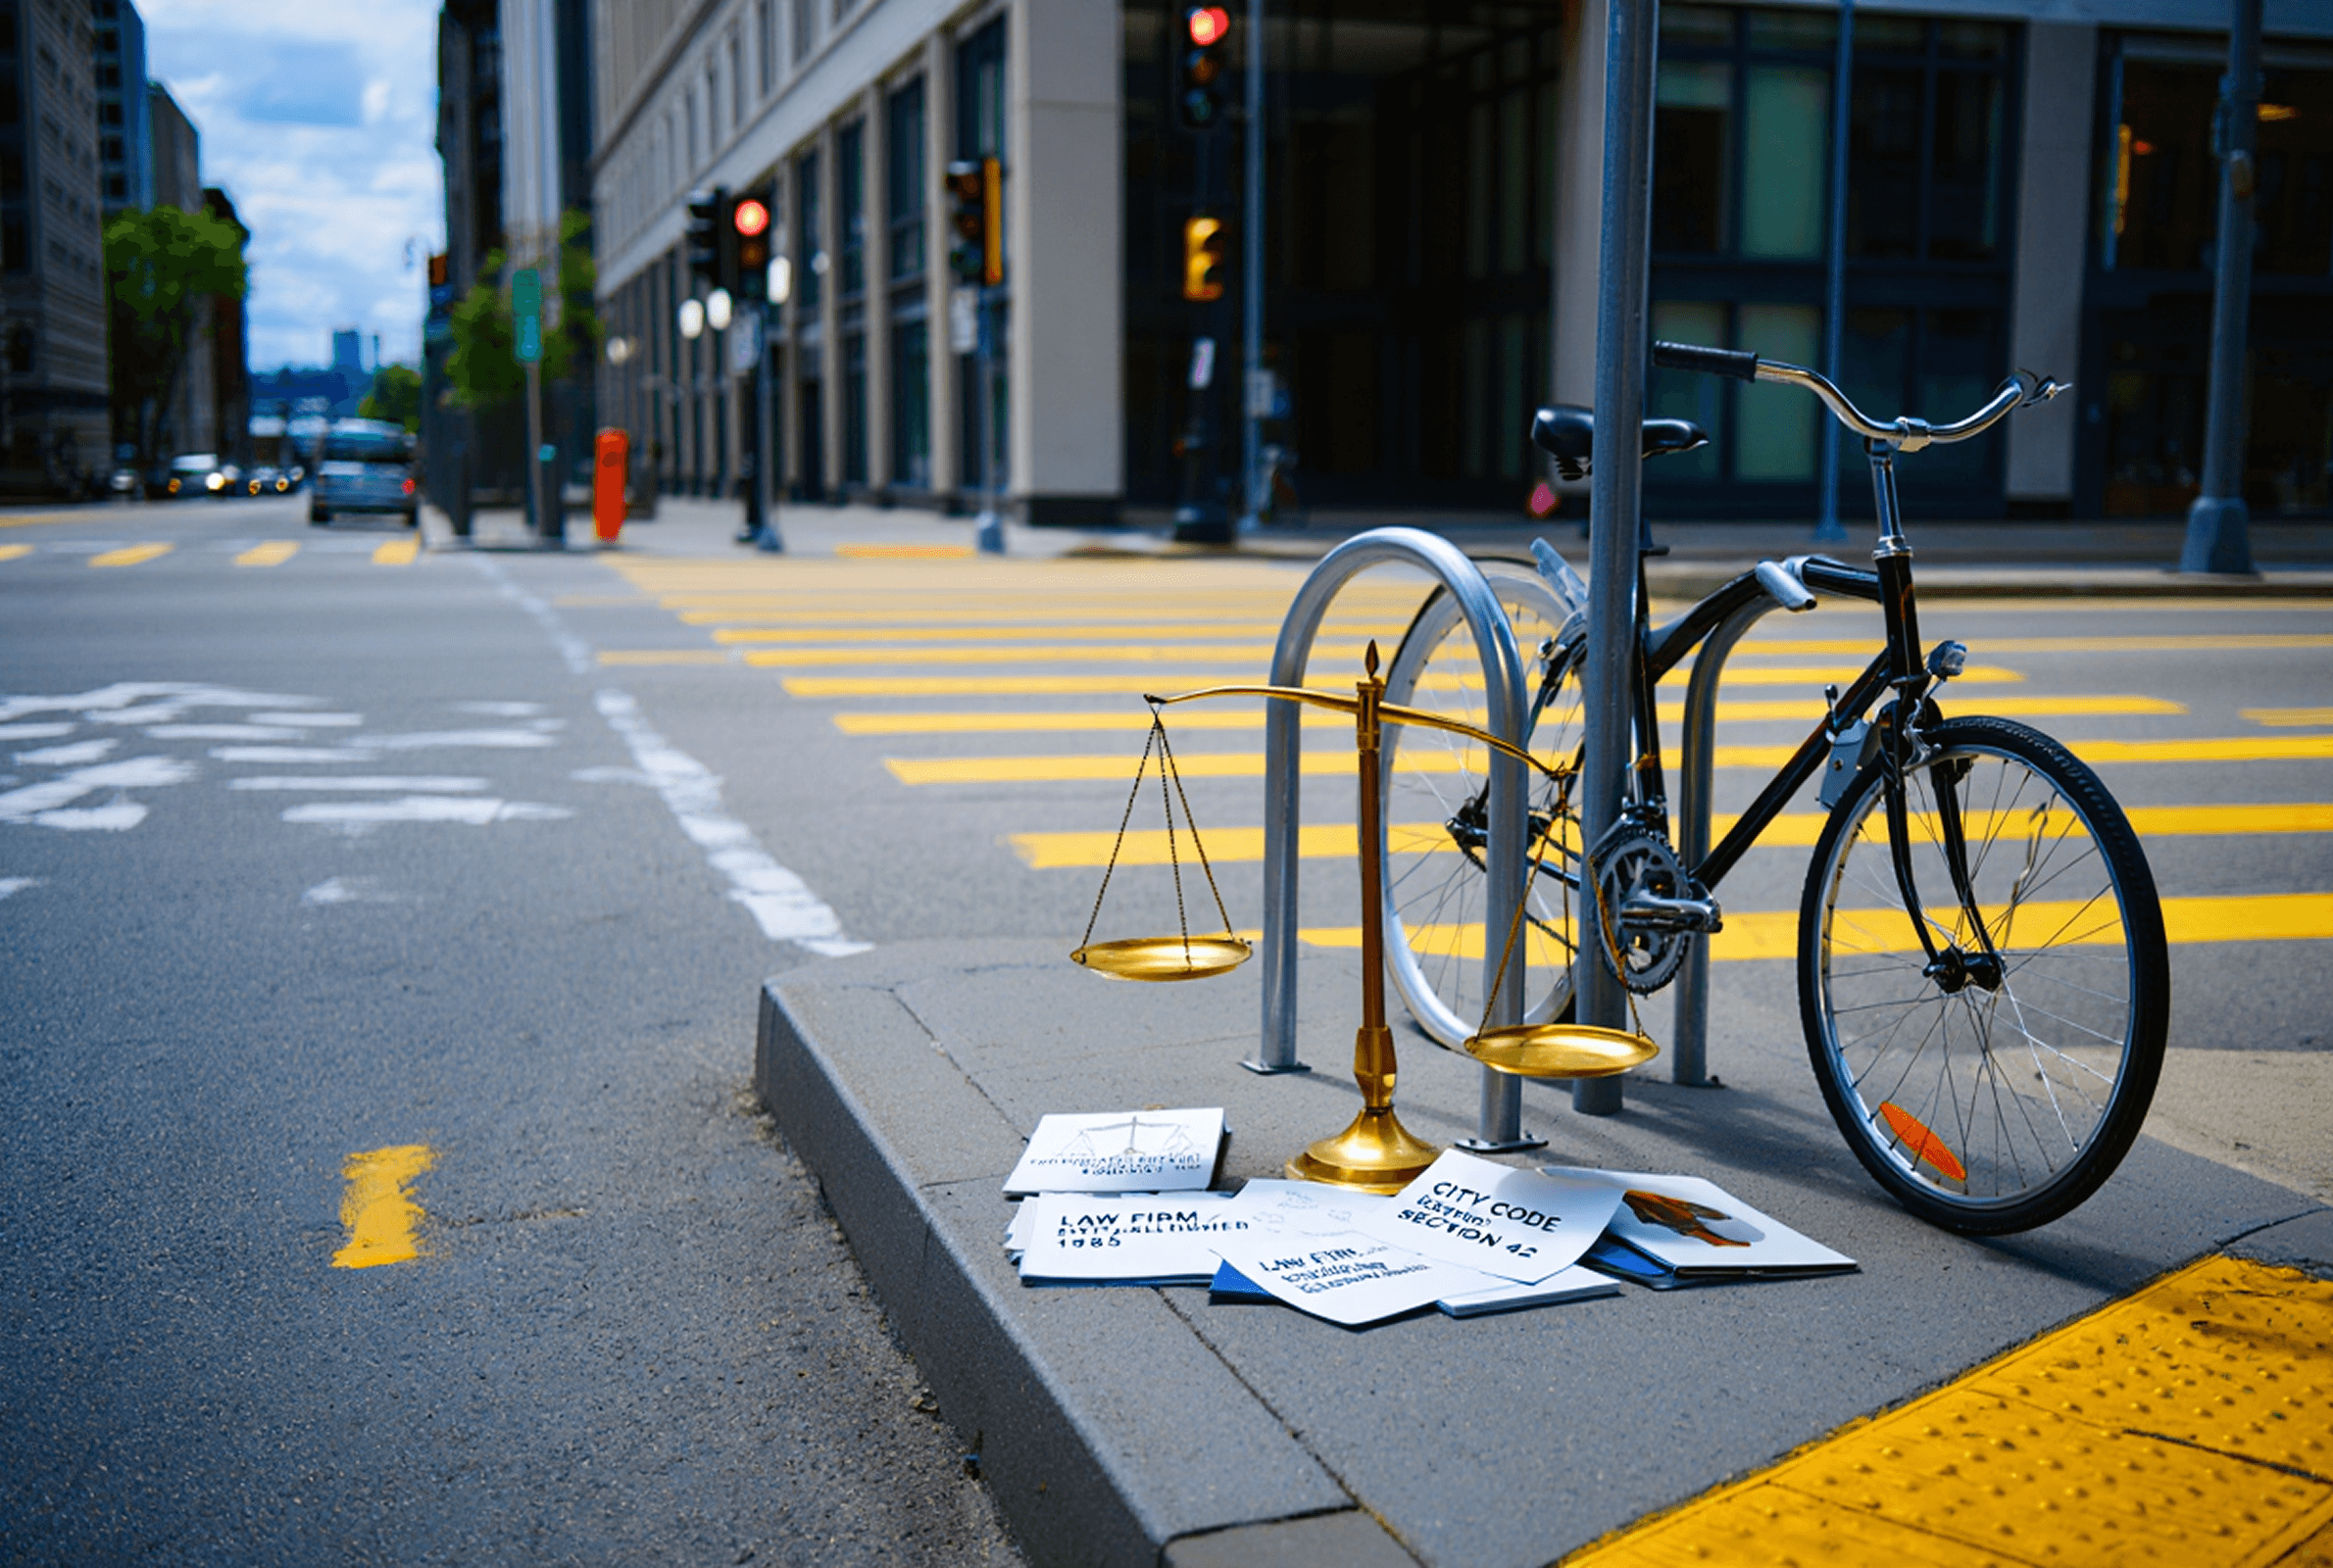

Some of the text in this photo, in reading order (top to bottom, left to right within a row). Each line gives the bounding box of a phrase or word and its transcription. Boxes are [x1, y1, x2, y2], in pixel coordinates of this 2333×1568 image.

[1061, 1213, 1119, 1227] LAW
[1433, 1182, 1490, 1206] CITY
[1490, 1201, 1562, 1233] CODE
[1398, 1208, 1503, 1248] SECTION
